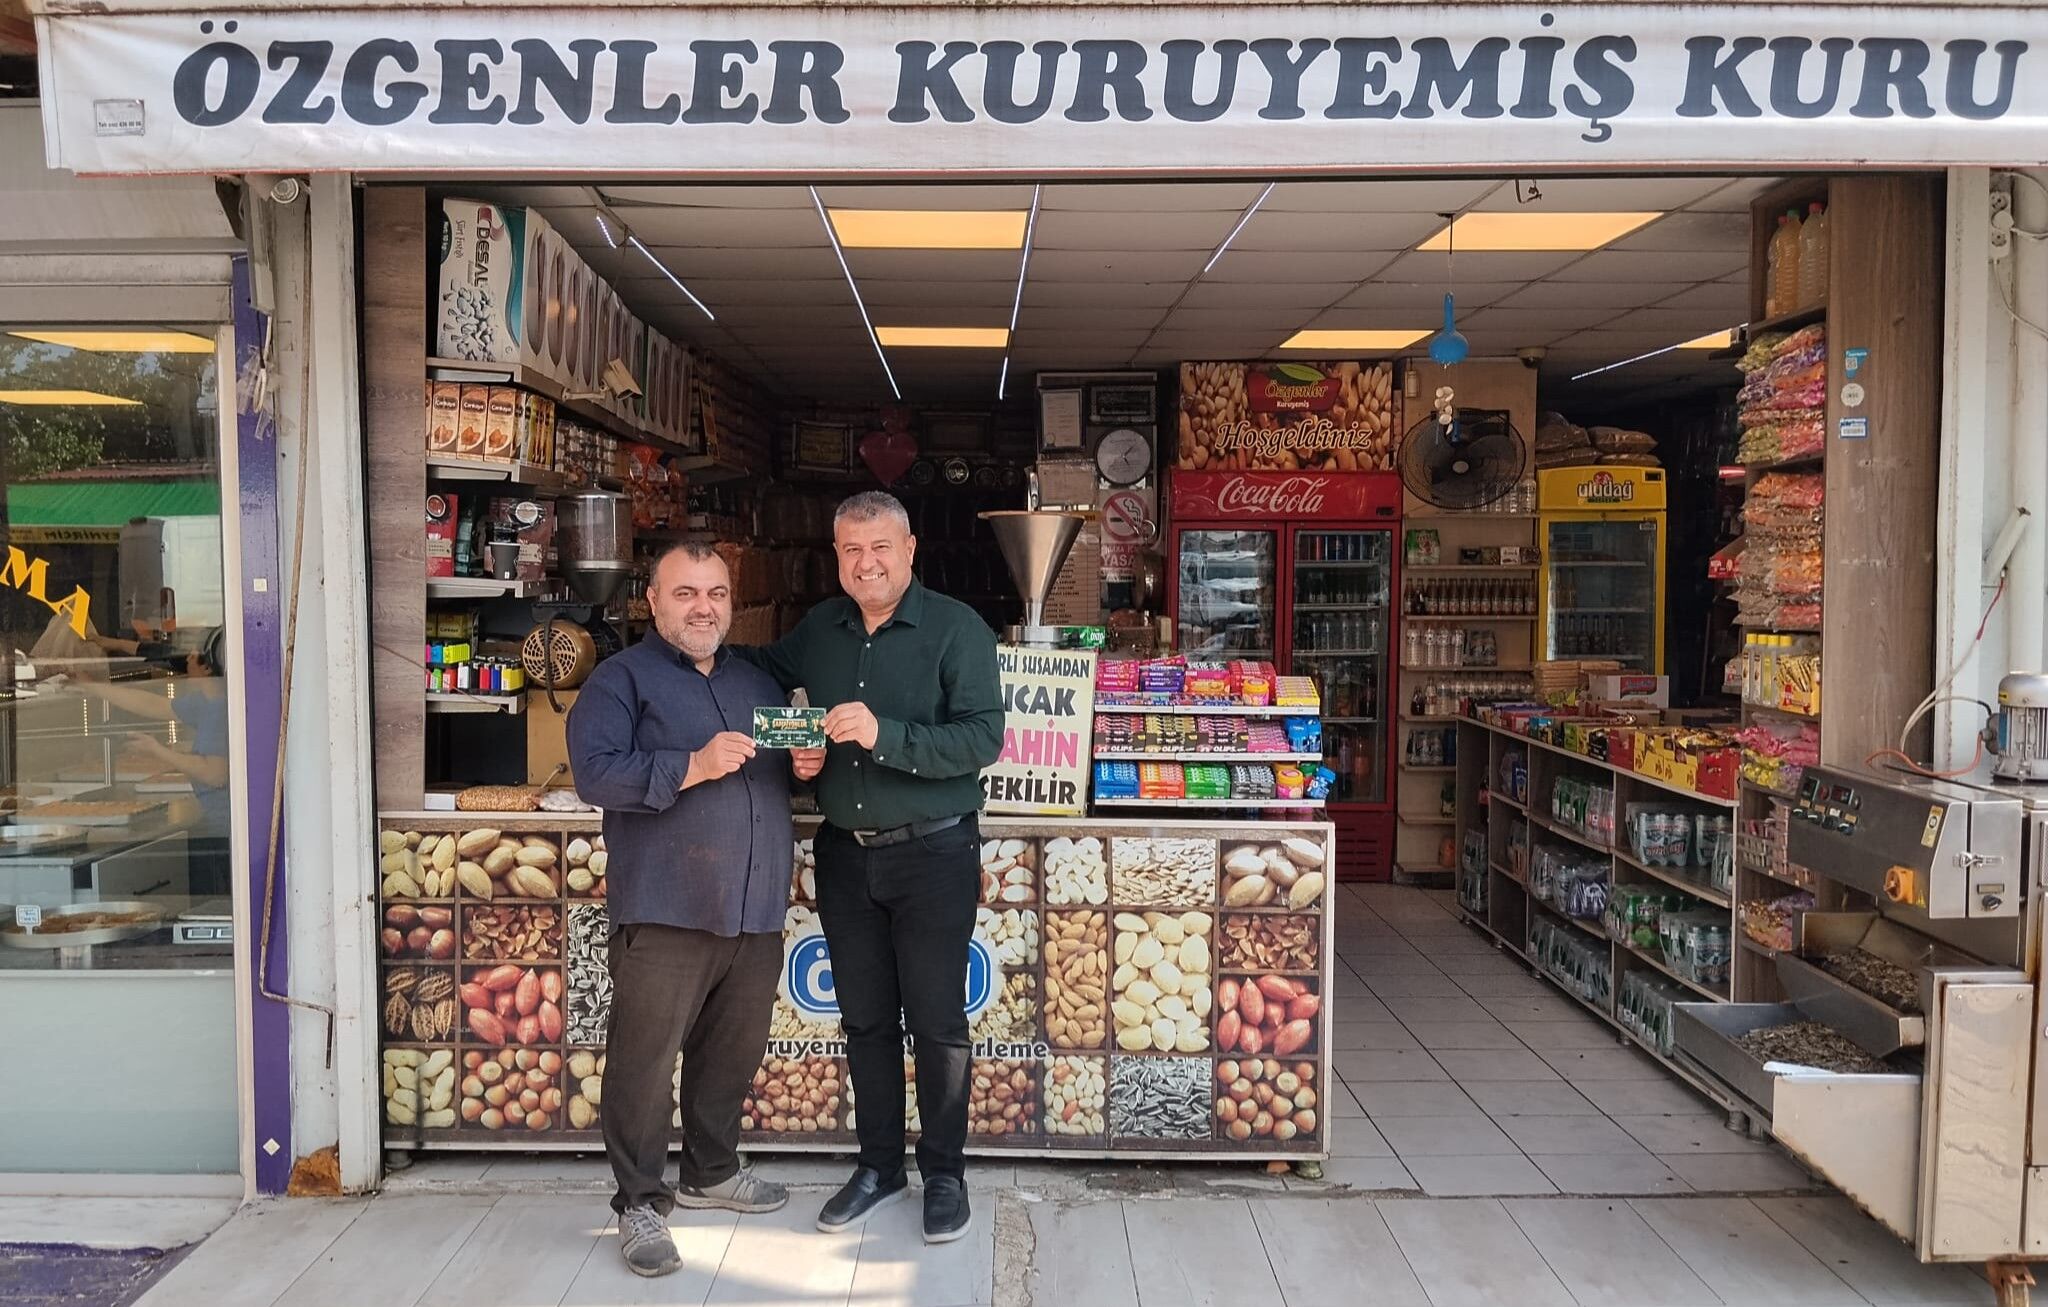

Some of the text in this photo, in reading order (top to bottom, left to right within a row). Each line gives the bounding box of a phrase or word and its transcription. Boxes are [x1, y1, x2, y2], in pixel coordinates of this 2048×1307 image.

[174, 13, 2029, 142] ÖZGENLER KURUYEMİŞ KURU
[474, 226, 491, 288] DESAL
[1264, 379, 1329, 401] Özgenler
[1215, 418, 1373, 457] Hoşgeldiniz
[1101, 553, 1136, 567] YASA
[998, 648, 1090, 678] RLİ SUSAMDAN
[1002, 683, 1076, 716] ICAK
[998, 719, 1078, 769] AHİN
[767, 1037, 1048, 1059] ruyem rleme
